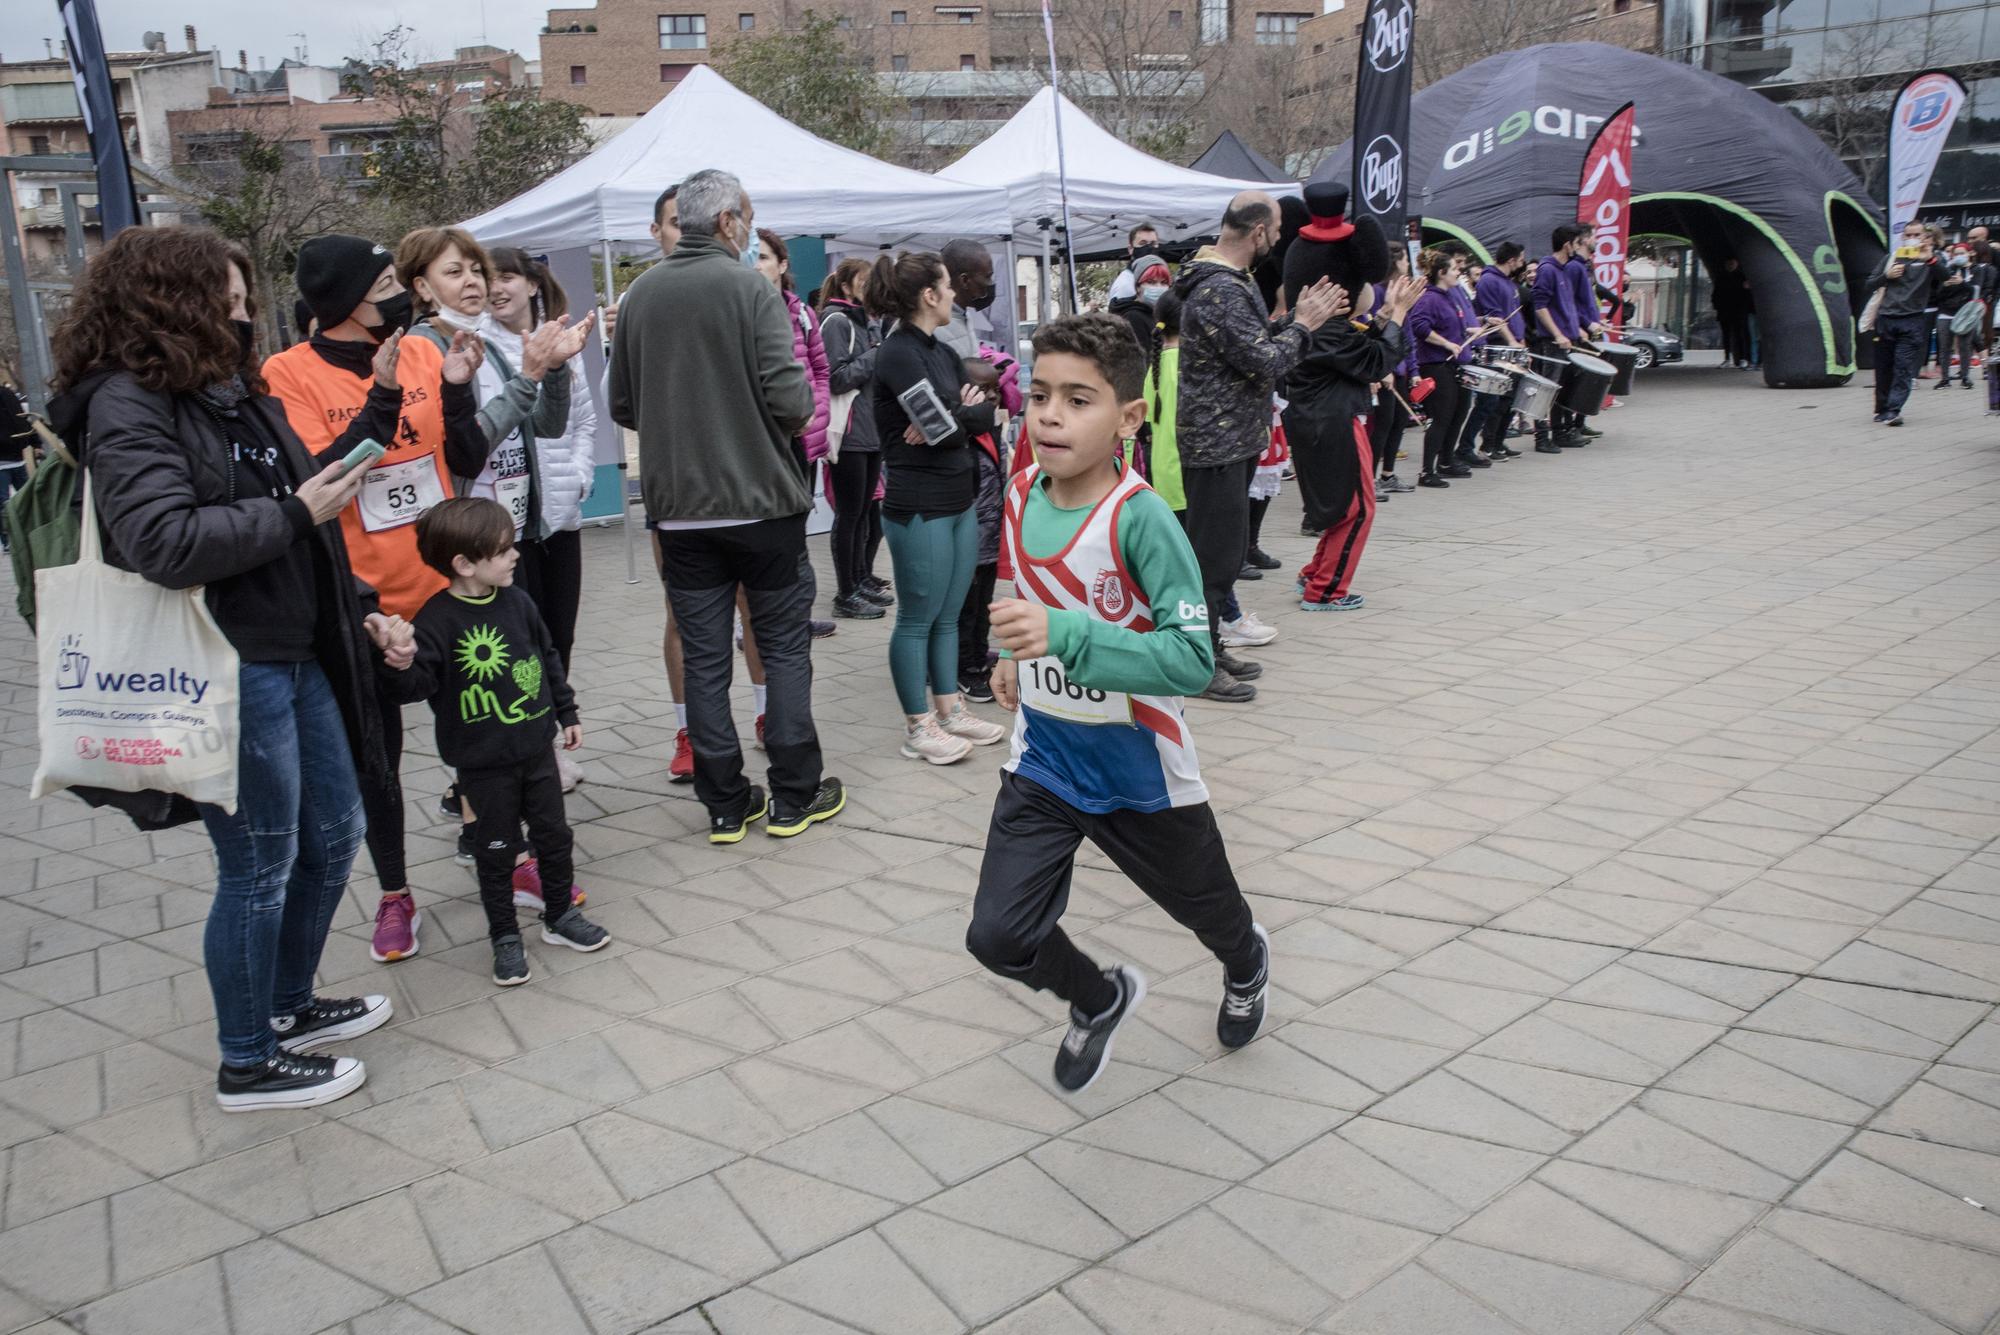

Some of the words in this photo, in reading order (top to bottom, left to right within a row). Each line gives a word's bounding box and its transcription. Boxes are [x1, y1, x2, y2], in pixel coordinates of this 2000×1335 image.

[387, 484, 417, 509] 53
[1178, 600, 1209, 620] be
[96, 668, 209, 704] wealty
